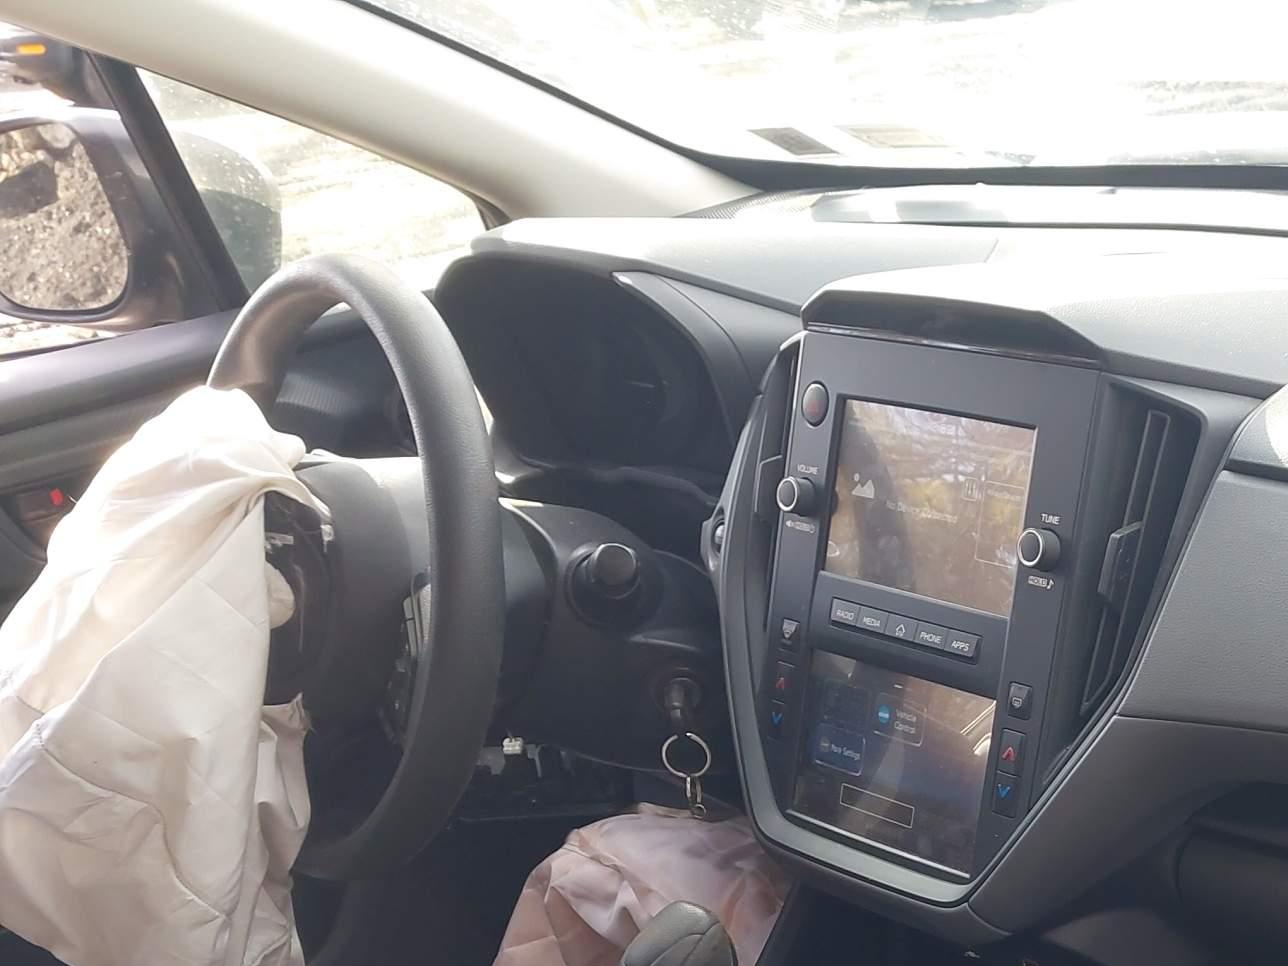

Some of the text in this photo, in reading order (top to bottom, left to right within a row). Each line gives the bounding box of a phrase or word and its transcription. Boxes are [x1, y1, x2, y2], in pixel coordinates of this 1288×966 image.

[1041, 513, 1060, 525] TUNE
[836, 609, 855, 620] RADIO
[863, 616, 881, 627] MEDIA
[919, 631, 943, 644] PHONE
[951, 640, 970, 651] APPS
